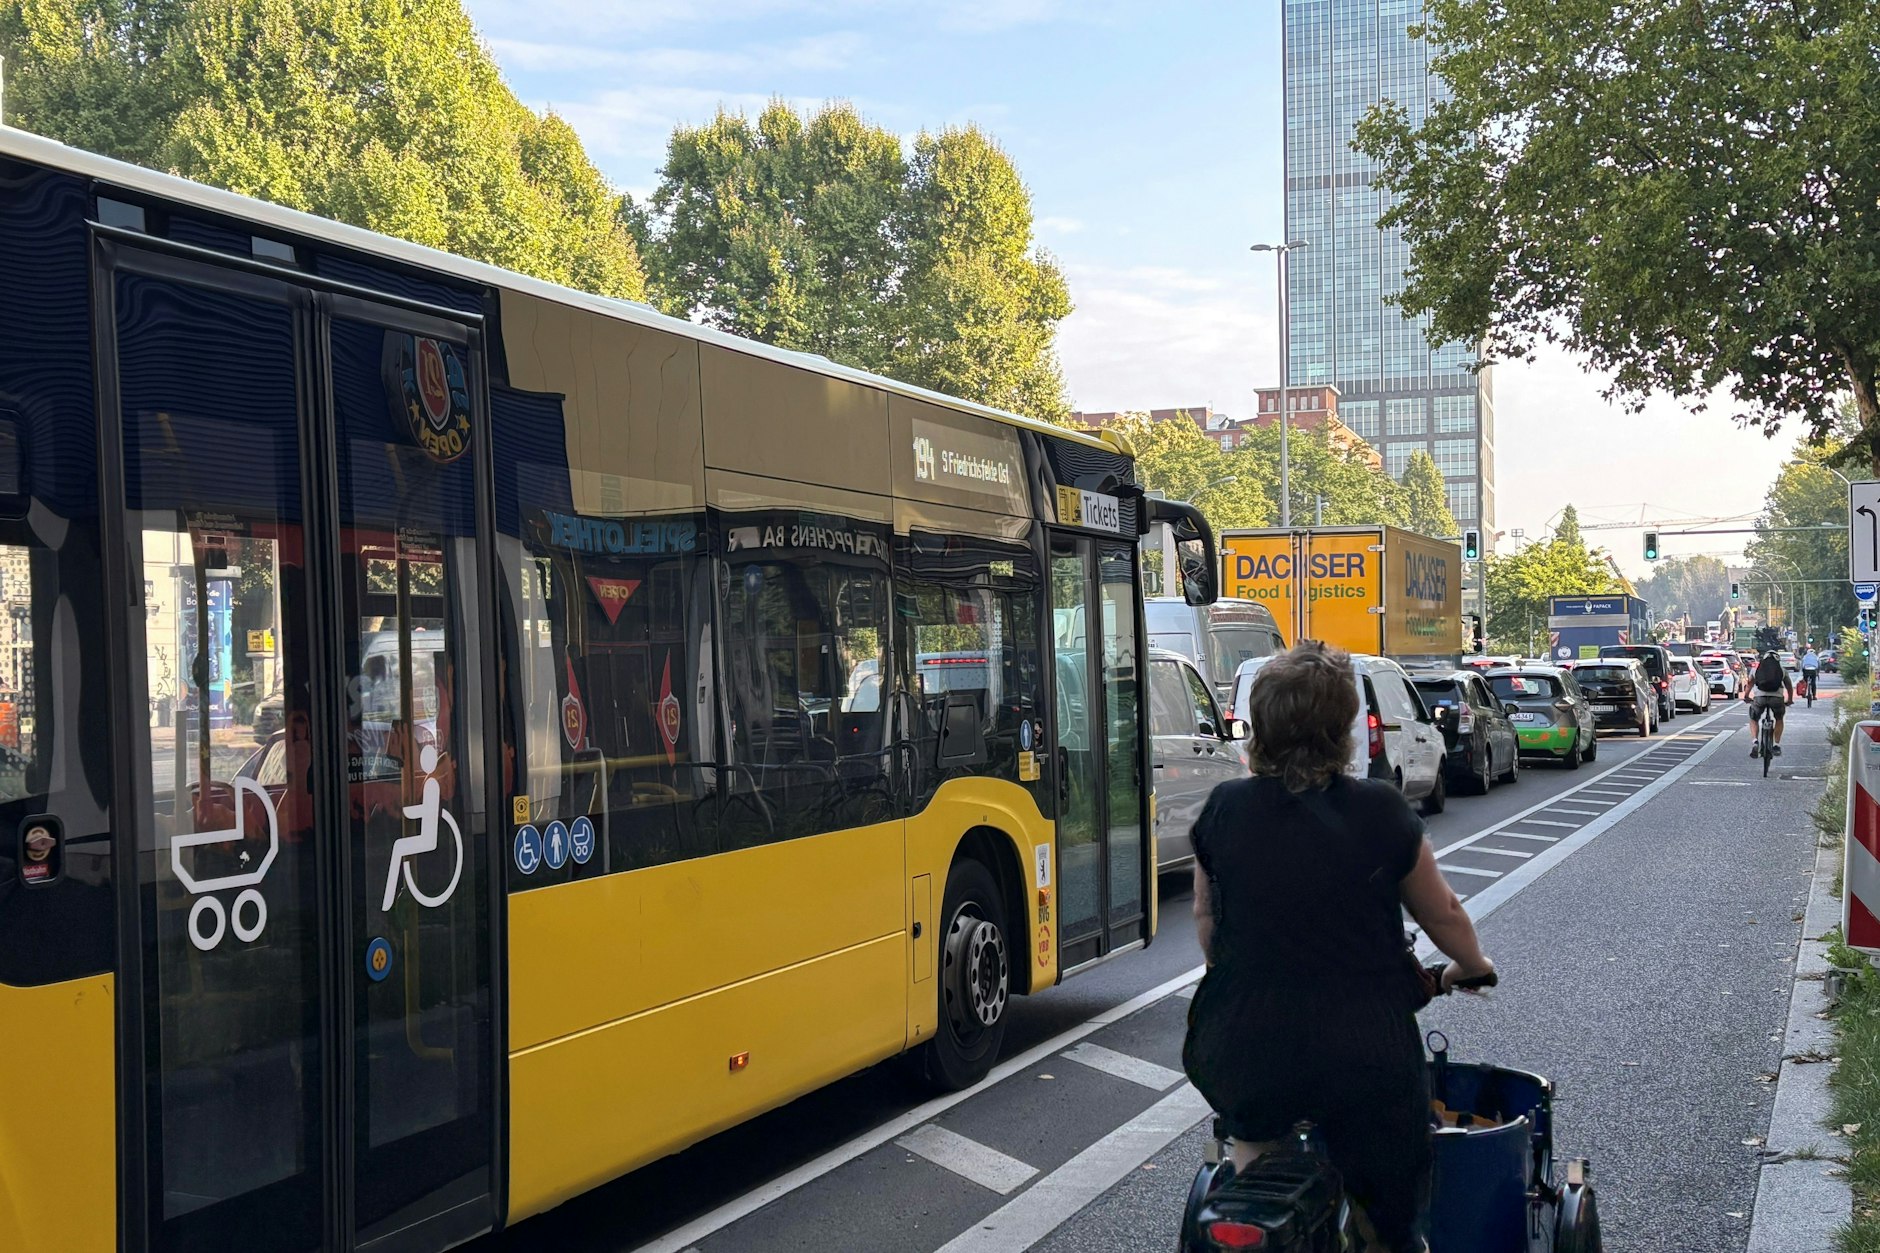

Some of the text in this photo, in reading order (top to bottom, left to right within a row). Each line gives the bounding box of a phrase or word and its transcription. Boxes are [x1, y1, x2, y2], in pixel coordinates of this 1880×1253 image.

[912, 436, 1009, 484] 194 S Friedrichsfelde Ost
[1083, 495, 1118, 528] Tickets
[1236, 553, 1365, 580] DACHSER
[1405, 550, 1447, 602] DACHSER
[1236, 584, 1279, 599] Food
[1038, 905, 1050, 924] BVG
